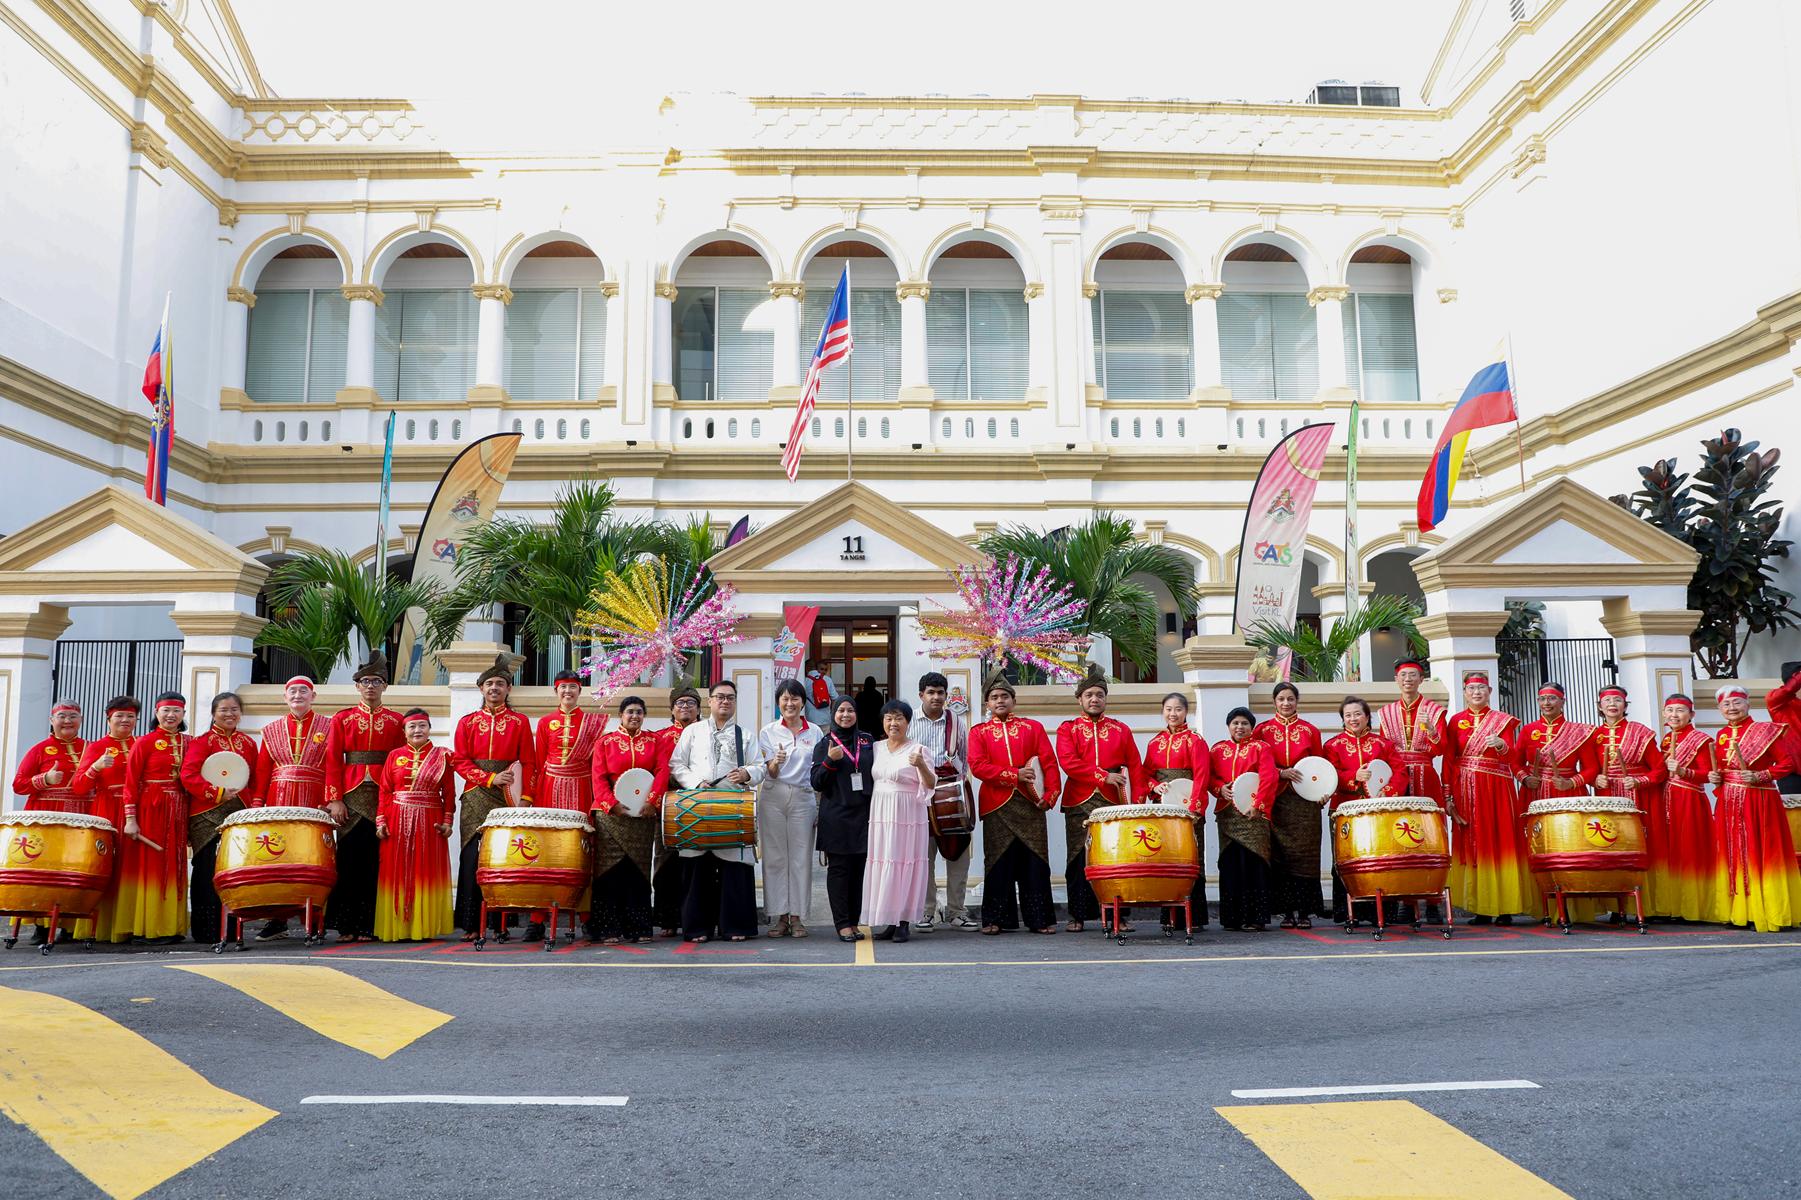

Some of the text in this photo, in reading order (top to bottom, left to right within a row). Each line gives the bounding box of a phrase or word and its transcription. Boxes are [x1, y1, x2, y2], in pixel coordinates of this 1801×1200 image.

[432, 538, 462, 562] CA
[842, 535, 864, 553] 11
[1253, 539, 1293, 565] CATS
